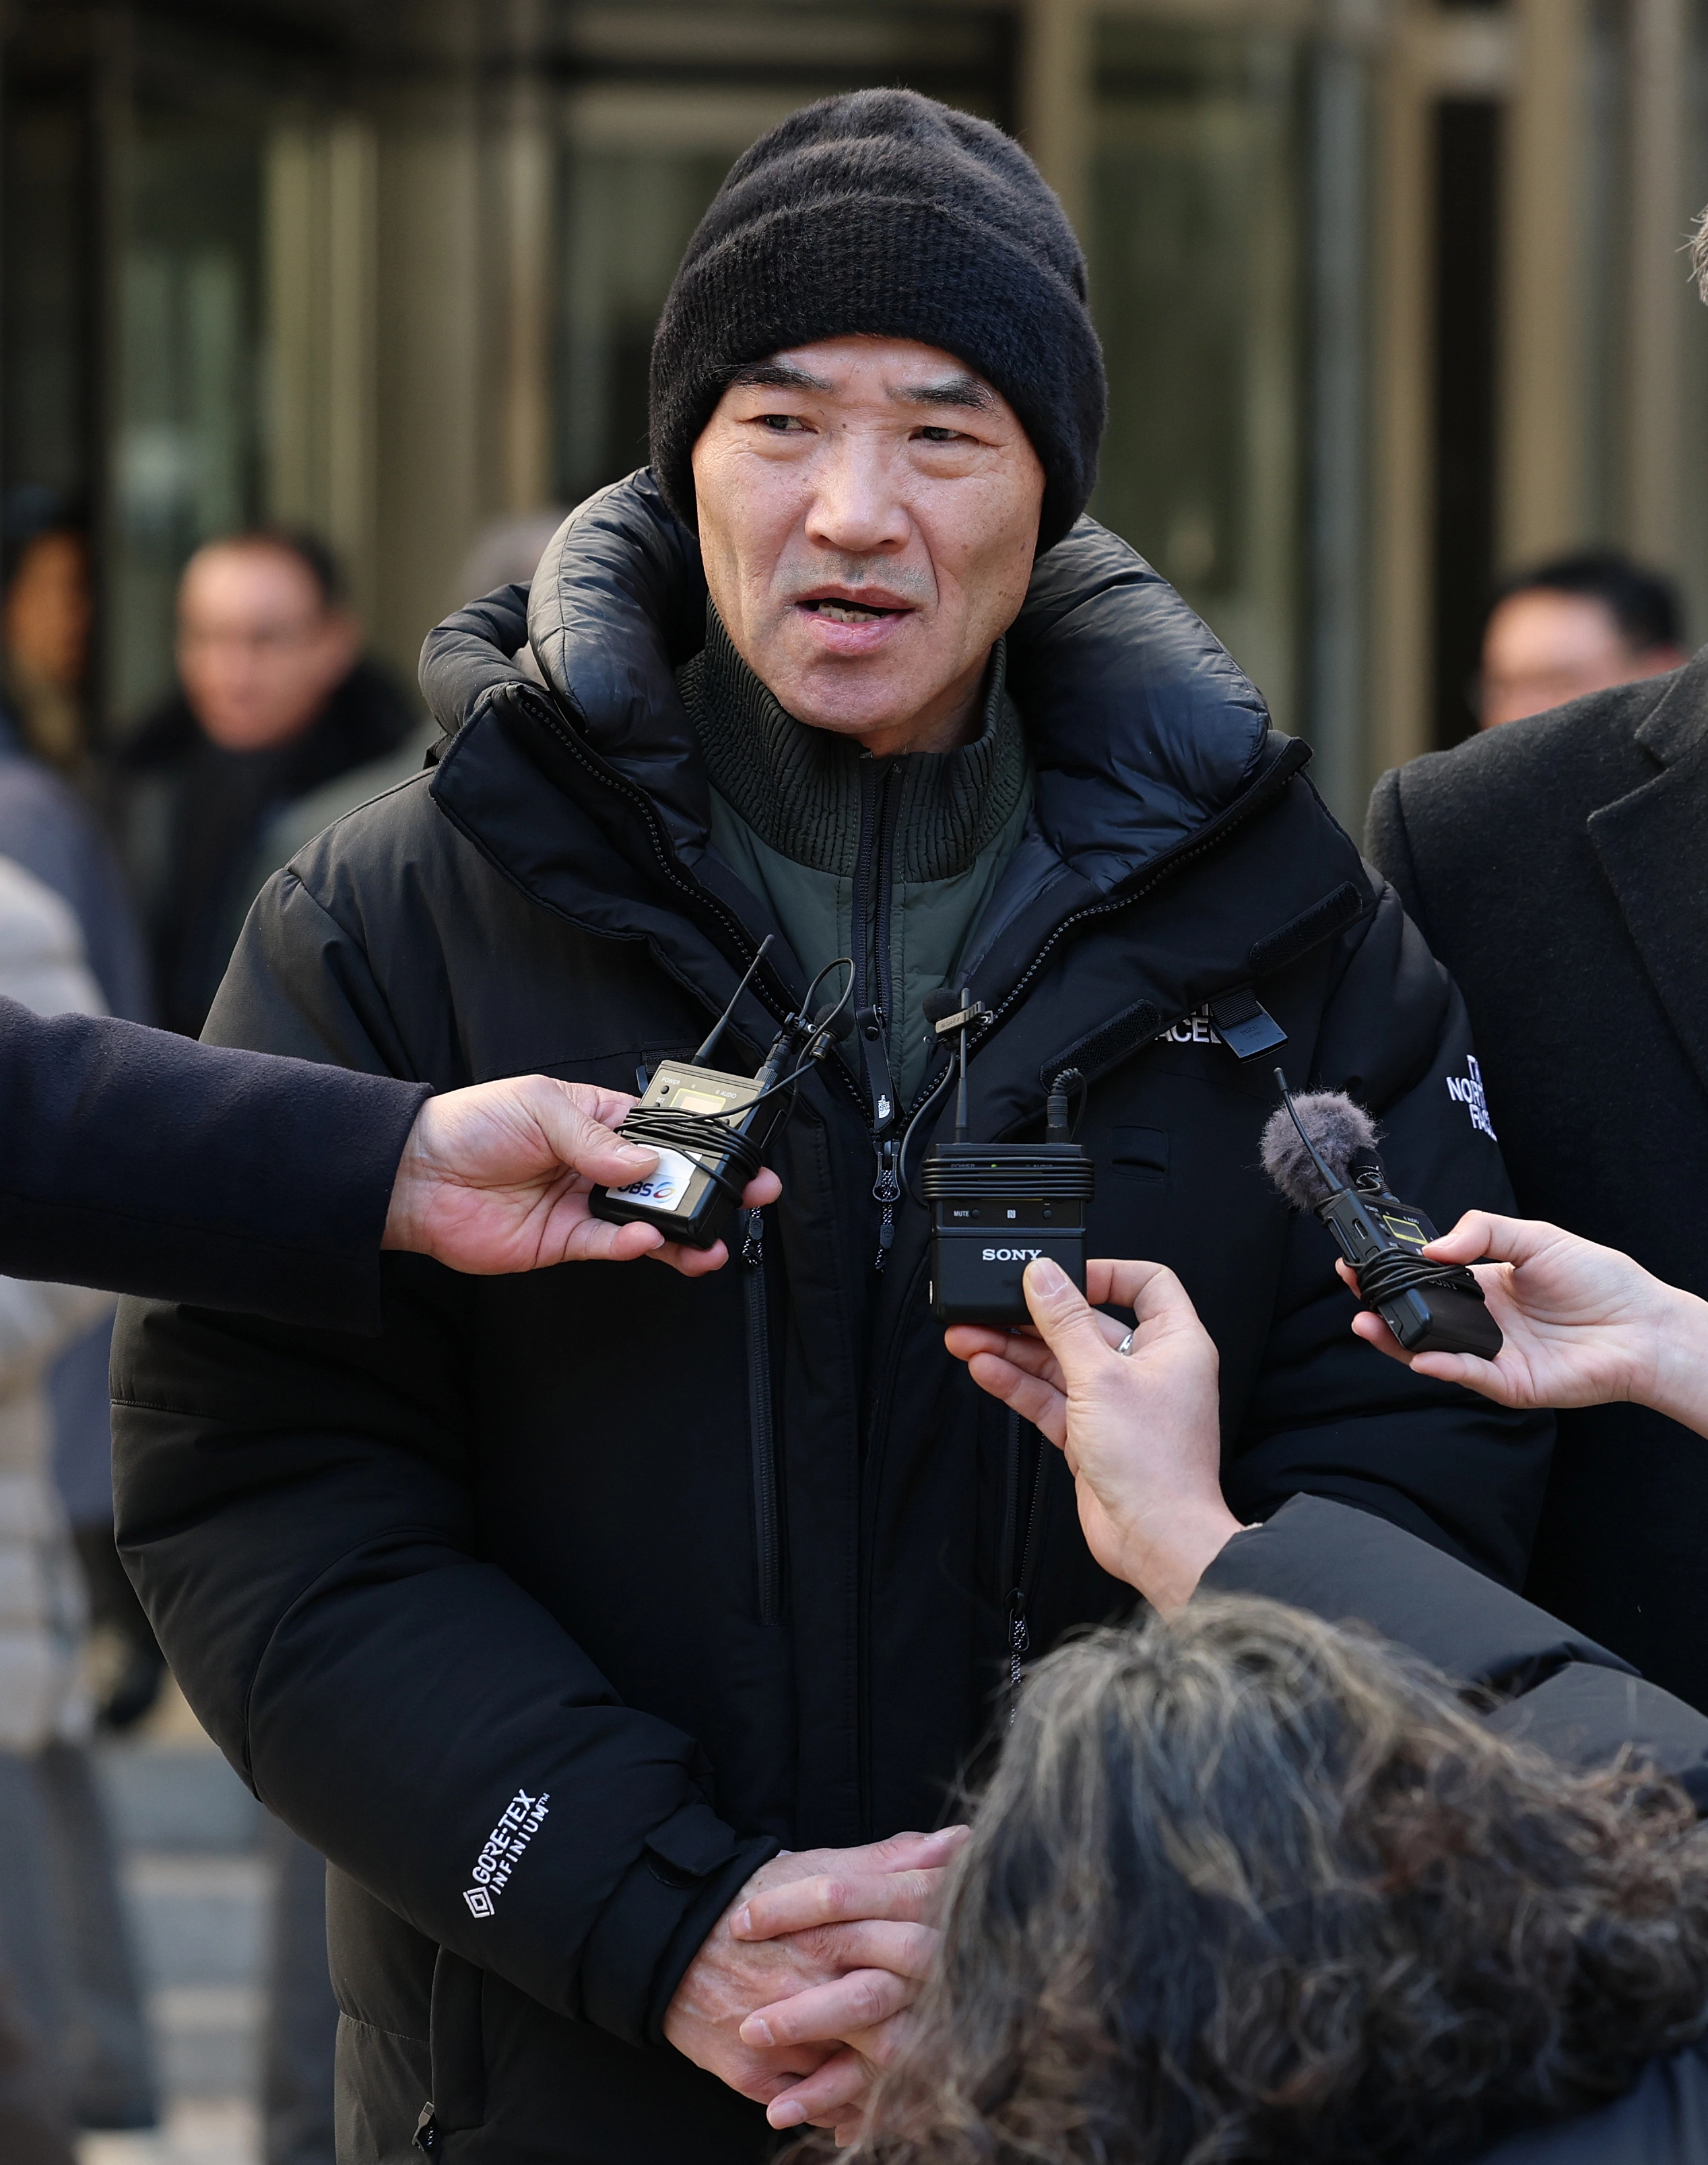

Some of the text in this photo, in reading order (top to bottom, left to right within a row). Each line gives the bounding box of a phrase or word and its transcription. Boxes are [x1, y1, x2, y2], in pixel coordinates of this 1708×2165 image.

[661, 1076, 681, 1086] POWER
[720, 1091, 737, 1099] AUDIO
[982, 1249, 1042, 1261] SONY
[471, 1788, 536, 1885] GORE-TEX
